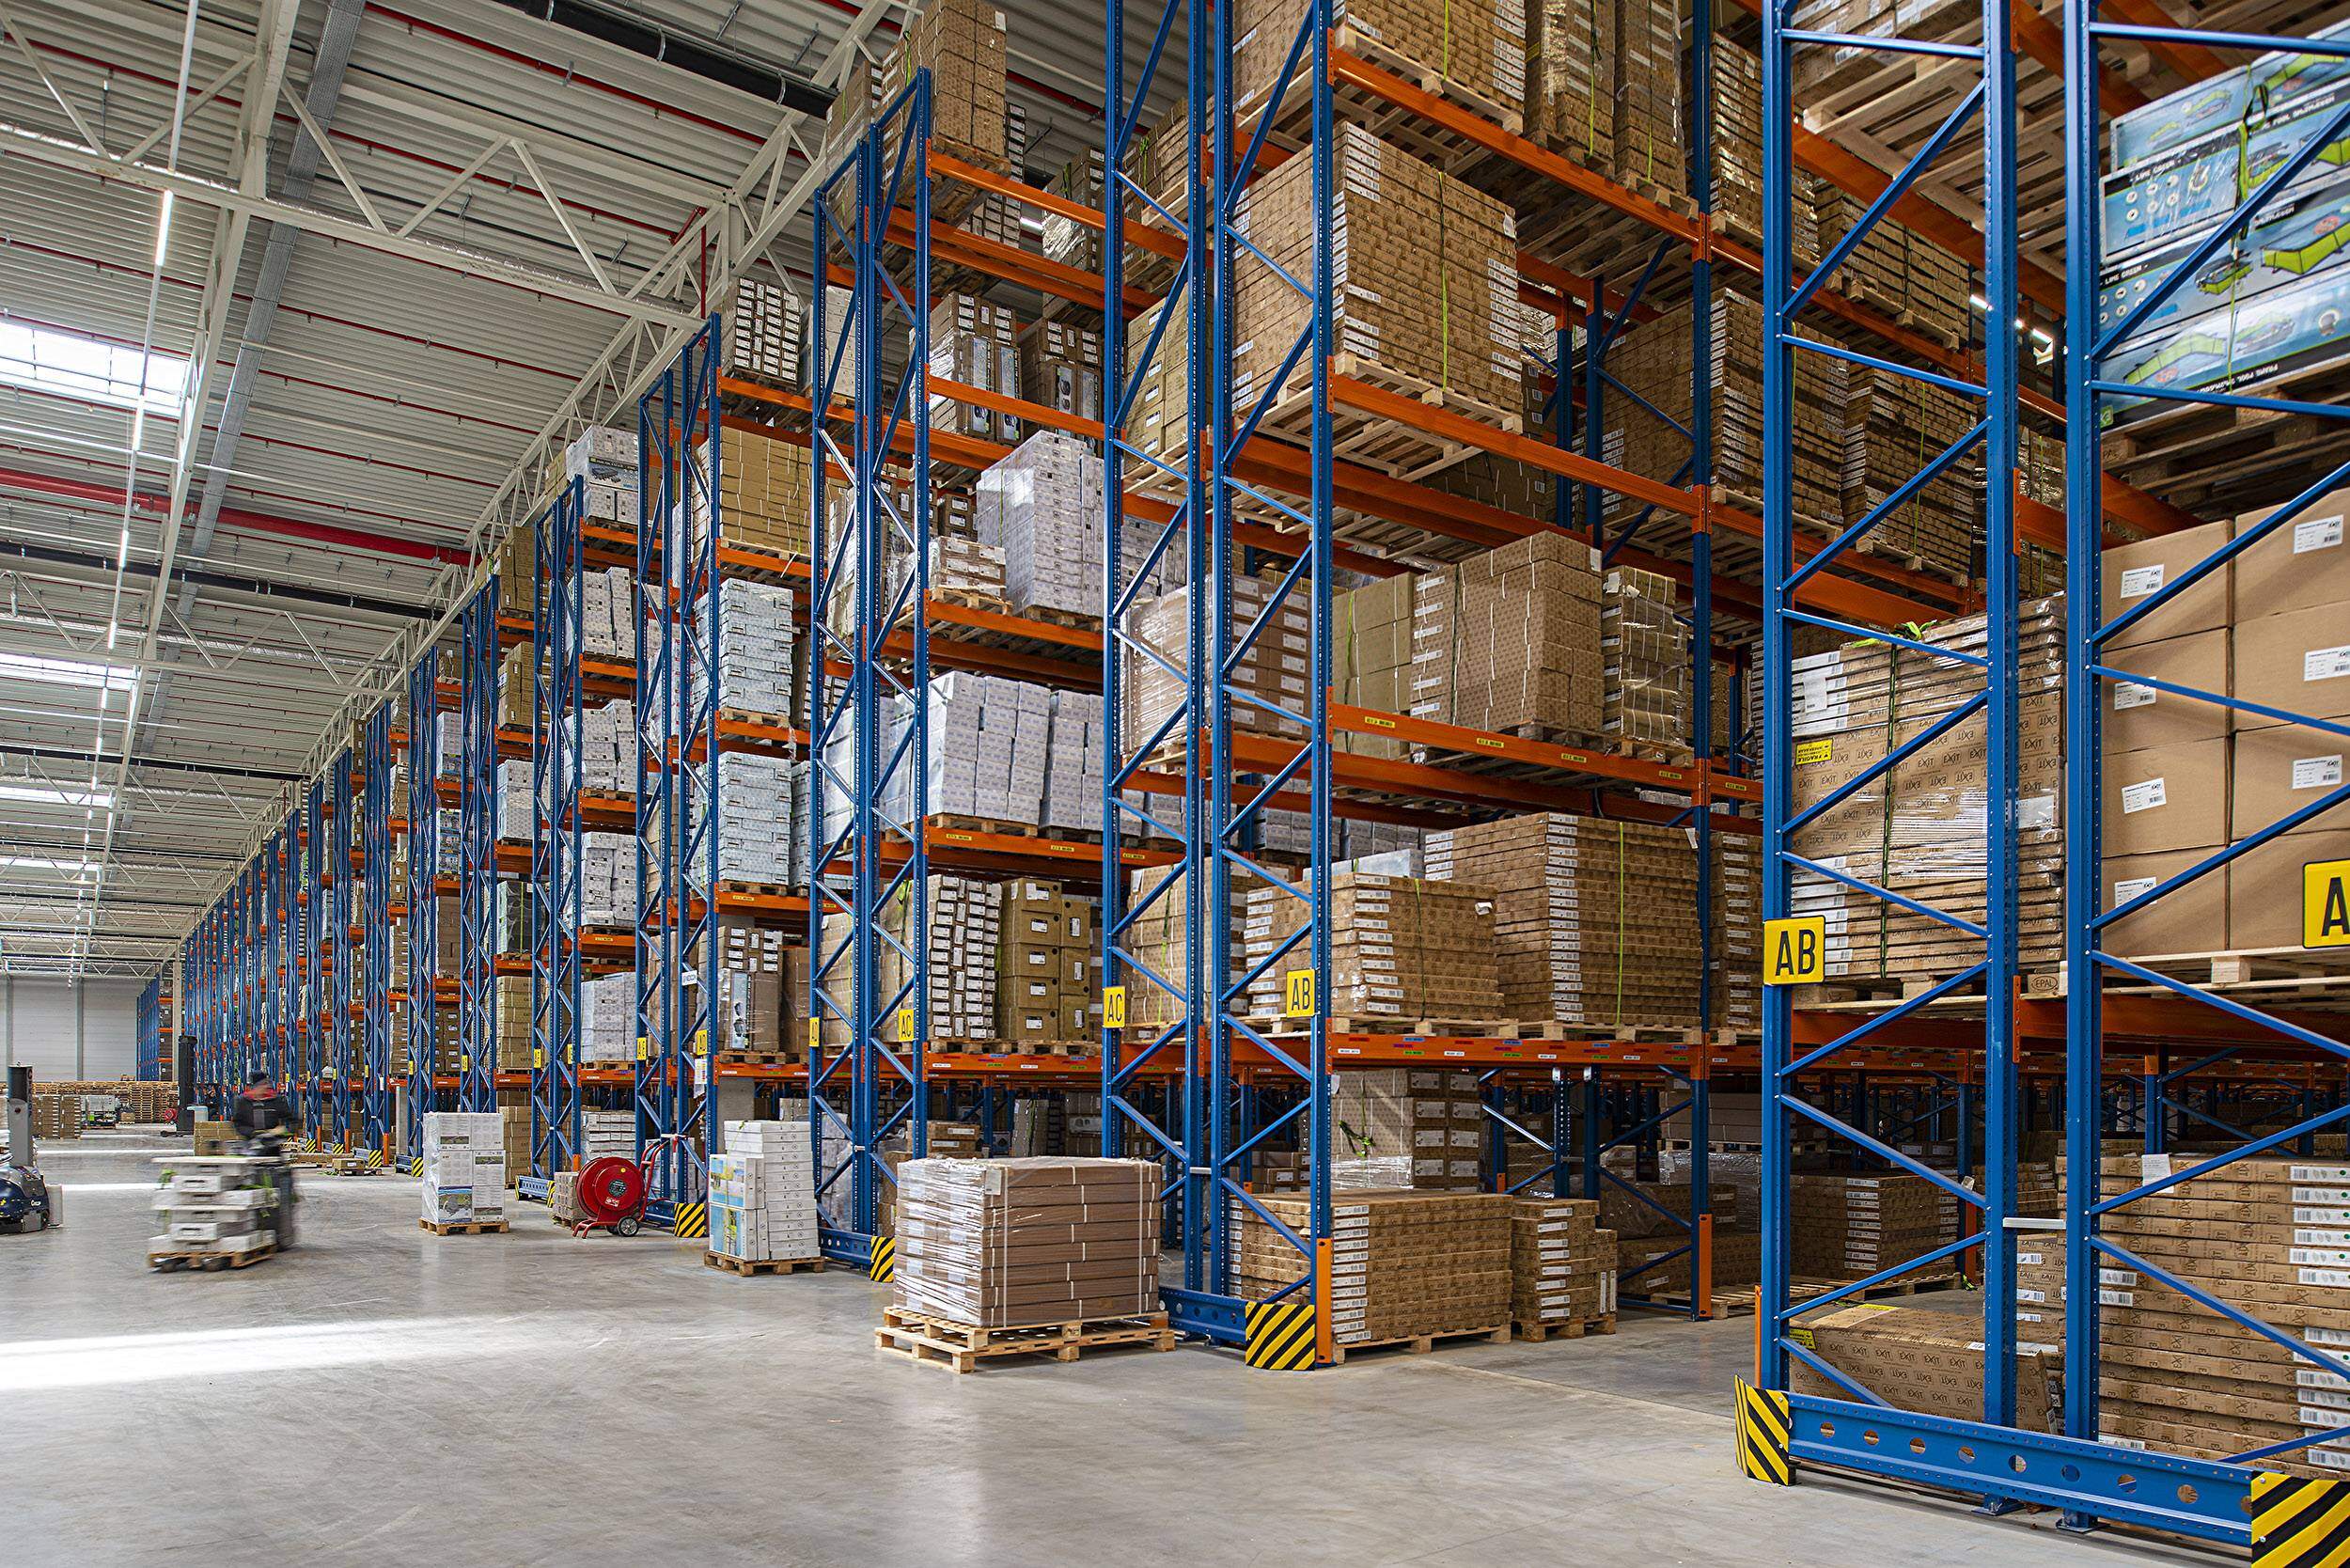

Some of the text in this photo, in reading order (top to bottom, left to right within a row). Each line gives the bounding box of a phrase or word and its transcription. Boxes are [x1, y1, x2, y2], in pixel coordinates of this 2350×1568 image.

[2026, 697, 2044, 707] EXIT
[2039, 715, 2057, 726] EXIT
[1956, 730, 1974, 741] EXIT
[2024, 739, 2043, 749] EXIT
[1918, 758, 1935, 768] EXIT
[1944, 753, 1961, 763] EXIT
[2039, 759, 2057, 769] EXIT
[1821, 776, 1837, 785] EXIT
[1930, 776, 1947, 787] EXIT
[1956, 772, 1973, 782] EXIT
[1798, 779, 1813, 789] EXIT
[1905, 781, 1921, 791] EXIT
[2024, 783, 2043, 792] EXIT
[1821, 814, 1836, 824] EXIT
[1843, 810, 1859, 820] EXIT
[1776, 929, 1816, 976] AB
[2036, 979, 2052, 987] EPAL
[1292, 978, 1310, 1011] AB
[1107, 994, 1122, 1023] AC
[901, 1014, 913, 1038] AC
[1853, 1345, 1868, 1356] EXIT
[1876, 1349, 1890, 1359] EXIT
[1900, 1351, 1916, 1361] EXIT
[1924, 1355, 1940, 1366] EXIT
[1950, 1357, 1966, 1368] EXIT
[1892, 1369, 1907, 1379] EXIT
[1917, 1372, 1932, 1383] EXIT
[1941, 1376, 1957, 1387] EXIT
[1966, 1379, 1983, 1390] EXIT
[1884, 1386, 1899, 1395] EXIT
[1908, 1389, 1923, 1399] EXIT
[1933, 1392, 1949, 1403] EXIT
[1957, 1396, 1973, 1407] EXIT
